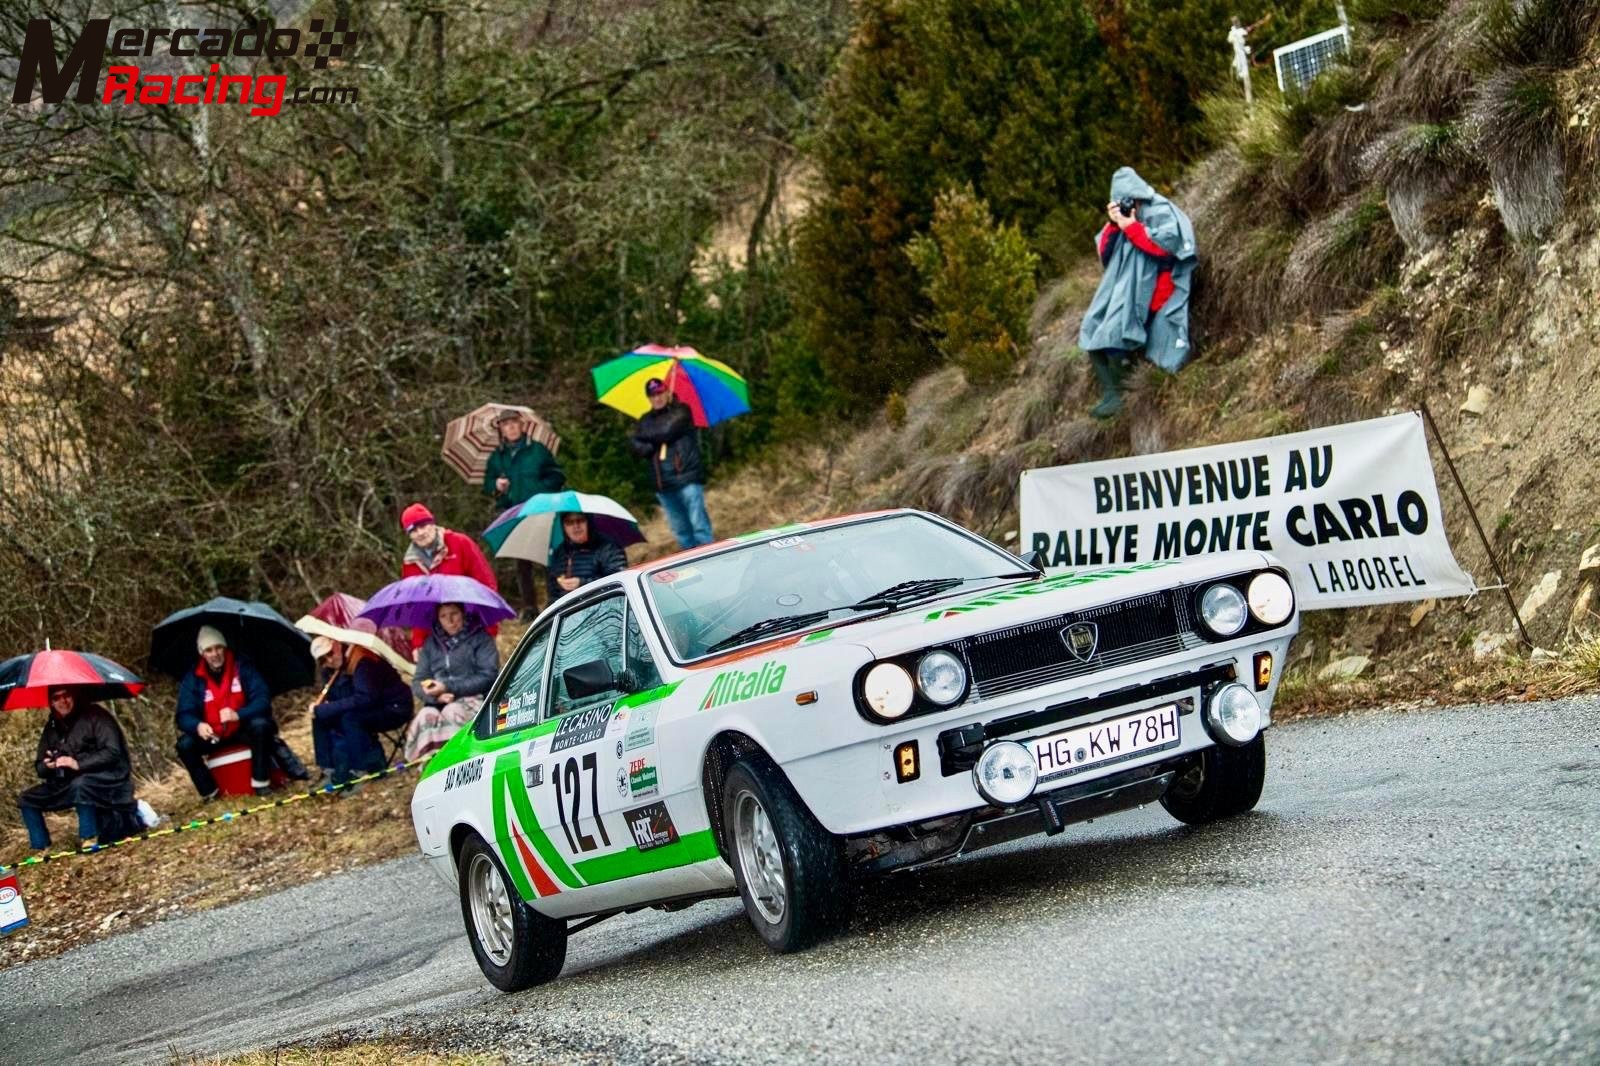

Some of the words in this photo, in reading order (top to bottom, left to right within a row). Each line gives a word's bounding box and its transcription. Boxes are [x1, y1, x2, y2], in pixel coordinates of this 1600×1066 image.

[1094, 455, 1271, 514] BIENVENUE
[1284, 444, 1333, 493] AU
[1032, 524, 1139, 567] RALLYE
[1153, 510, 1273, 560] MONTE
[1285, 489, 1429, 547] CARLO
[1308, 555, 1427, 593] LABOREL
[698, 660, 788, 712] Alitalia
[568, 703, 612, 733] CASINO
[1036, 738, 1072, 771] HG
[1089, 724, 1121, 758] KW
[1128, 710, 1176, 747] 78H
[552, 752, 612, 854] 127
[631, 816, 655, 845] HRT
